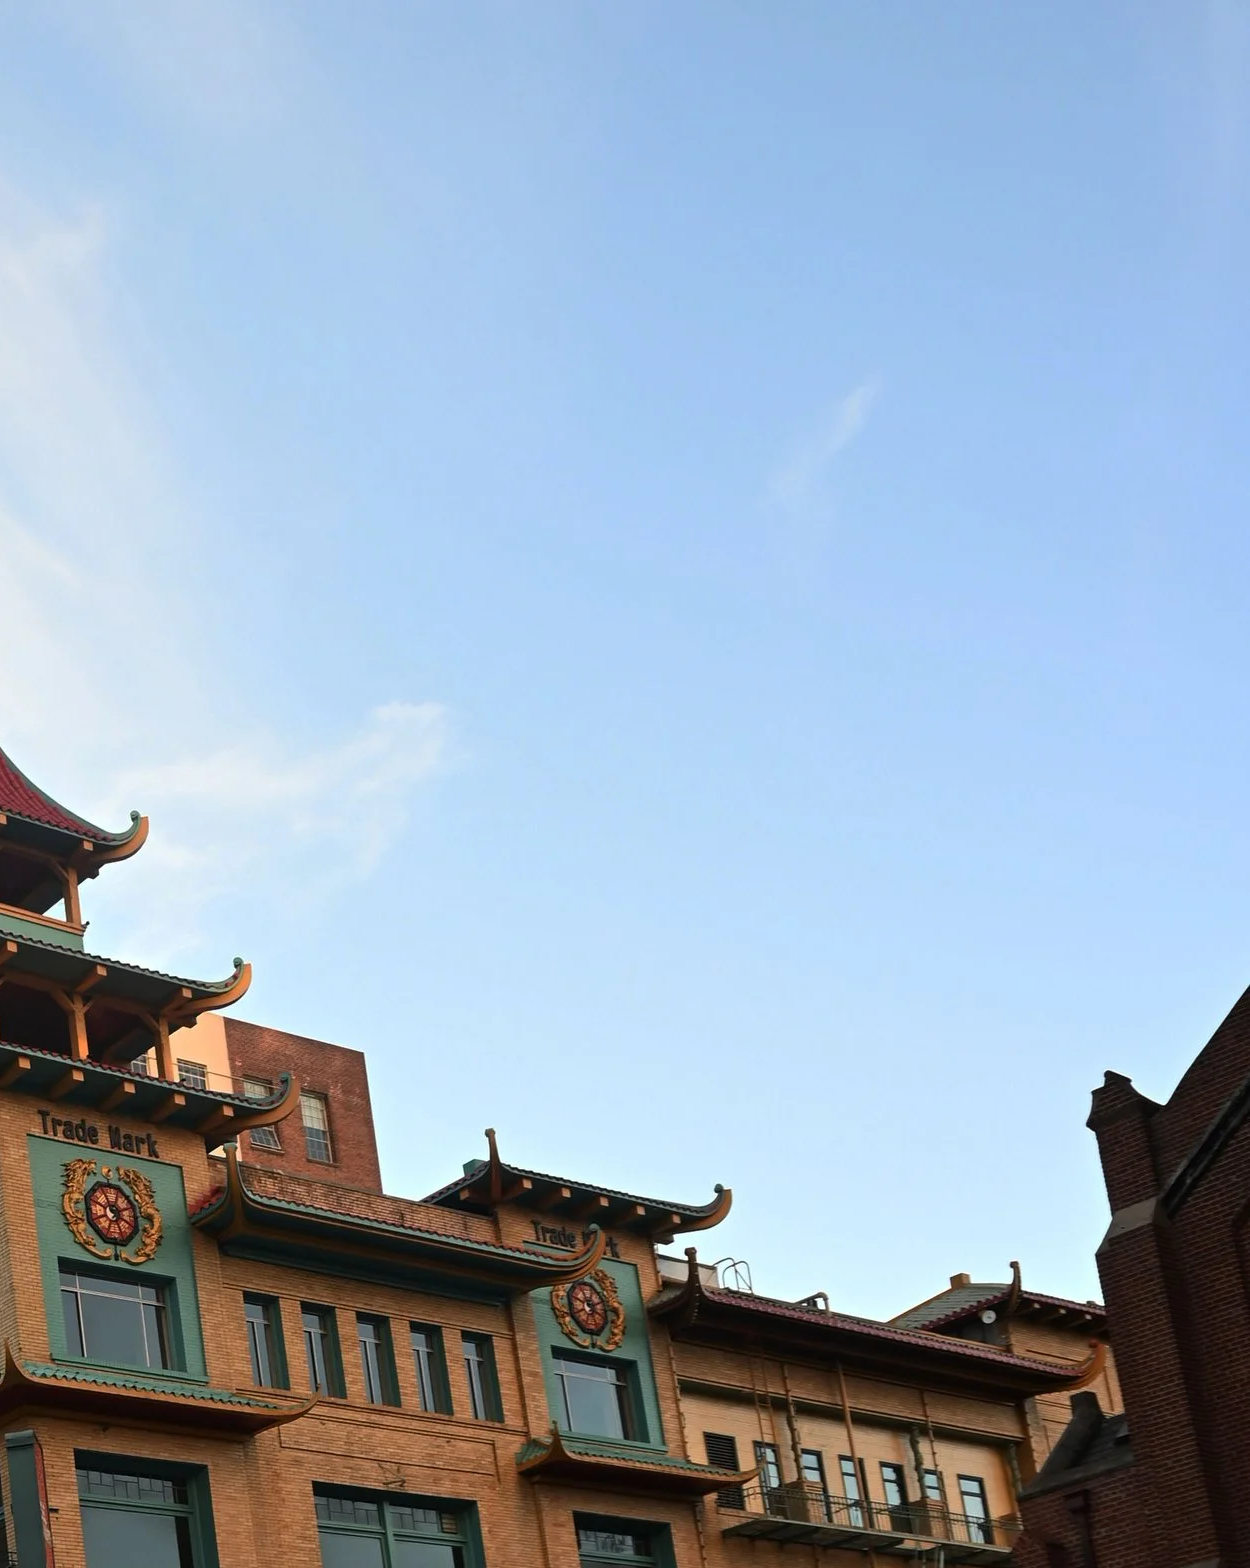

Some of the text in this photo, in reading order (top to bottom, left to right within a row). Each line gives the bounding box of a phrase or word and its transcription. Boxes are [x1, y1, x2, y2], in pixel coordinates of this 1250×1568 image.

[38, 1108, 160, 1159] Trade Mark
[530, 1219, 577, 1249] Trade
